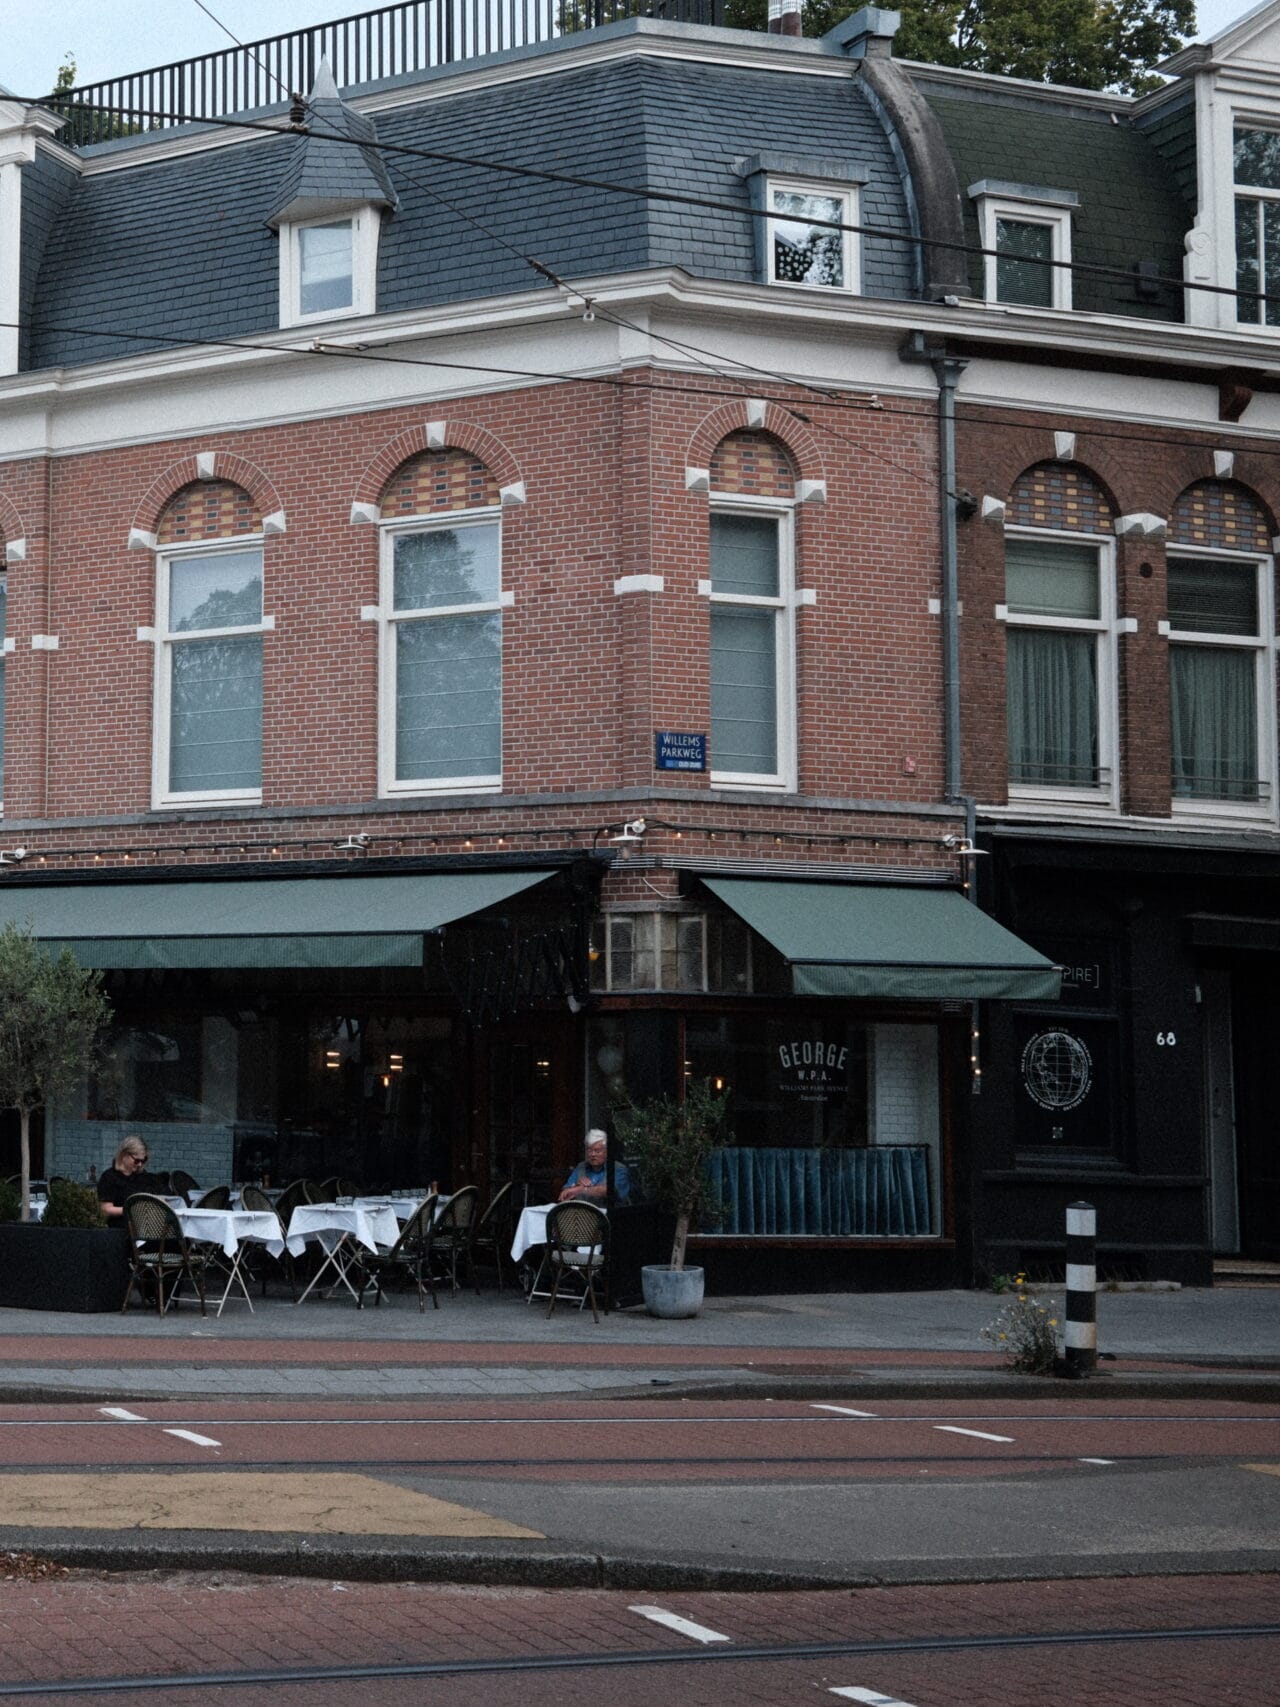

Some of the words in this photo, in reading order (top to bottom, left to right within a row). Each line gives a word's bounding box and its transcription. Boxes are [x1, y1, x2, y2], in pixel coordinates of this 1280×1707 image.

[663, 735, 701, 746] WILLEMS
[661, 747, 702, 759] PARKWEG
[1156, 1032, 1176, 1046] 68
[779, 1041, 848, 1070] GEORGE
[798, 1070, 832, 1081] W.P.A.
